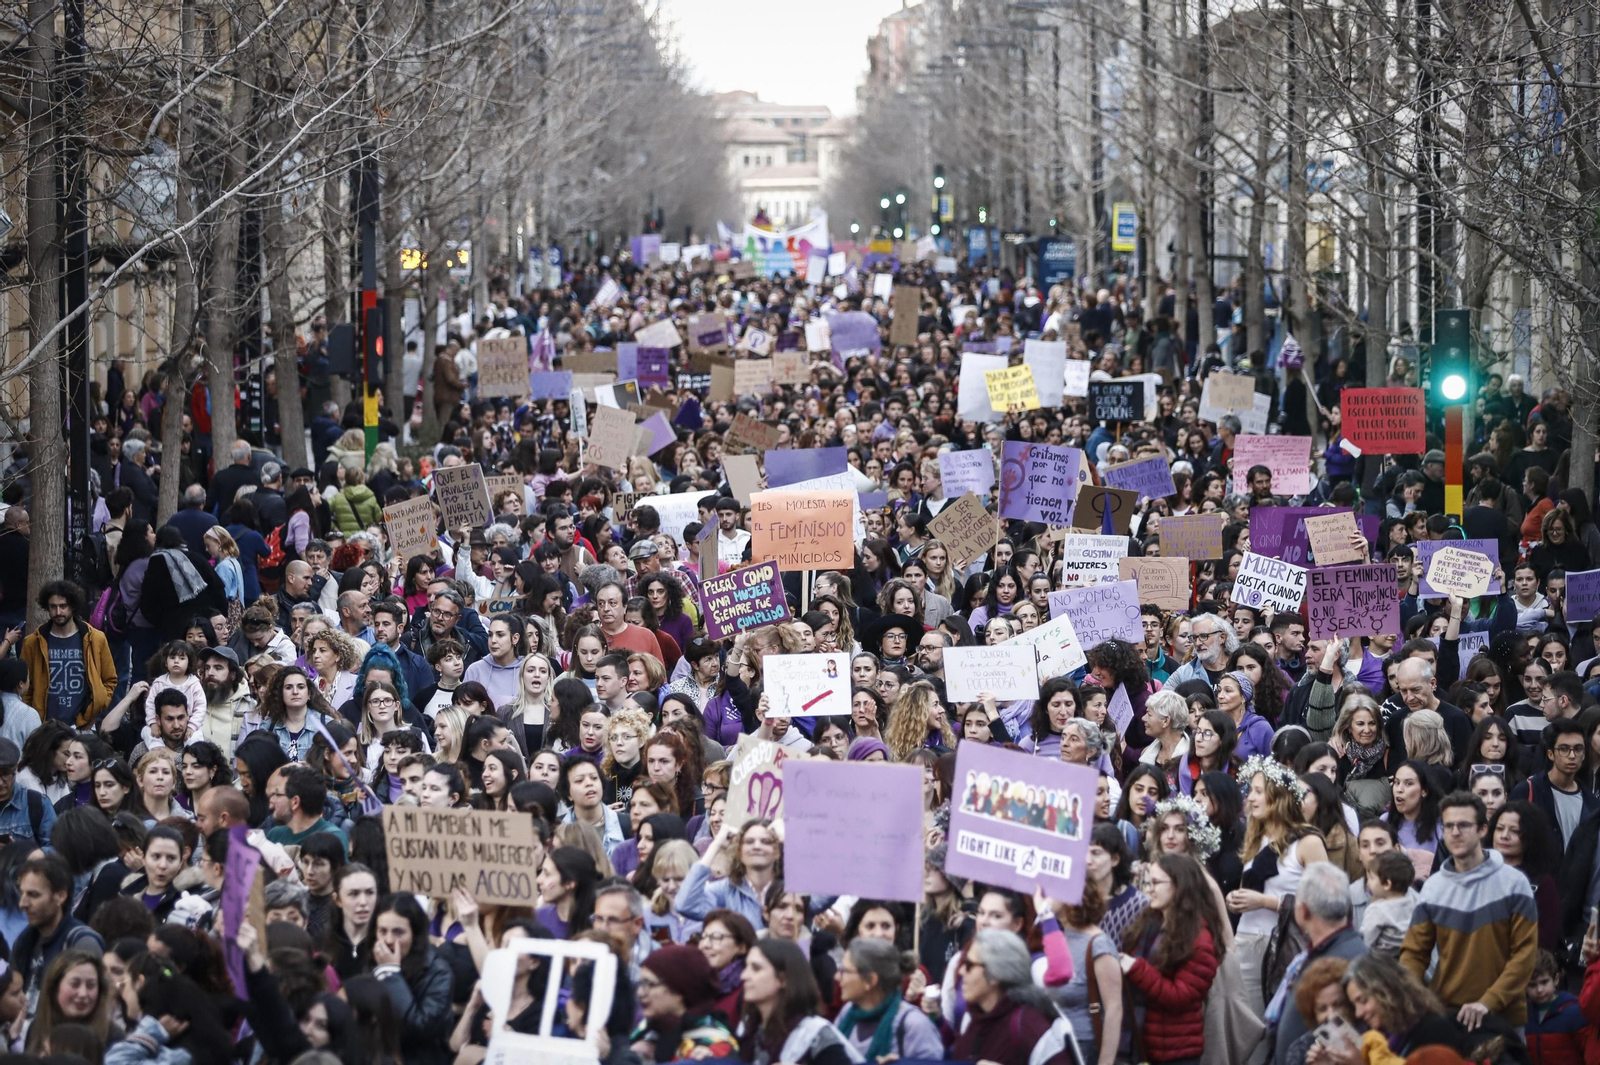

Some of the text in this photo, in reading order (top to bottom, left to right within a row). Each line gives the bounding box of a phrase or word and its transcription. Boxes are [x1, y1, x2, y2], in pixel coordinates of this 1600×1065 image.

[1029, 446, 1069, 464] Gritamos
[1031, 461, 1048, 471] por
[436, 469, 471, 487] QUE EL
[1028, 474, 1064, 490] que no
[440, 482, 480, 498] PRIVILEGIO
[464, 492, 474, 501] TE
[445, 500, 485, 515] NUBLE LA
[758, 502, 773, 511] LES
[786, 499, 827, 511] MOLESTA
[1025, 491, 1063, 509] tienen
[407, 513, 430, 526] TIEMPO
[934, 499, 973, 534] QUE SER
[949, 512, 978, 537] MUJER
[394, 528, 416, 541] SE HA
[754, 520, 846, 541] EL FEMINISMO
[947, 538, 960, 551] NO
[959, 527, 997, 561] LA VIDA
[1082, 549, 1113, 559] GUSTAN
[1066, 561, 1108, 570] MUJERES
[1244, 554, 1307, 586] MUJER ME
[1437, 560, 1489, 575] PATRIARCAL
[703, 565, 774, 598] PELEAS COMO
[1066, 573, 1080, 582] NO
[1312, 567, 1396, 586] EL FEMINISMO
[1432, 577, 1473, 589] ALEJARME
[1054, 586, 1121, 607] NO SOMOS
[1236, 574, 1301, 602] GUSTA CUANDO
[1236, 586, 1262, 606] NO
[1312, 585, 1345, 602] SERÁ
[708, 595, 731, 612] UNA
[755, 596, 772, 610] FUE
[1323, 606, 1335, 617] NO
[720, 622, 734, 635] UN
[965, 650, 976, 659] TE
[732, 741, 772, 786] CUERPO
[388, 811, 511, 838] A MI TAMBIÉN ME
[390, 836, 537, 867] GUSTAN LAS MUJERES
[960, 835, 991, 855] FIGHT
[994, 844, 1016, 863] LIKE
[1041, 855, 1066, 875] GIRL
[394, 867, 405, 892] Y
[410, 867, 432, 893] NO
[475, 869, 532, 900] ACOSO
